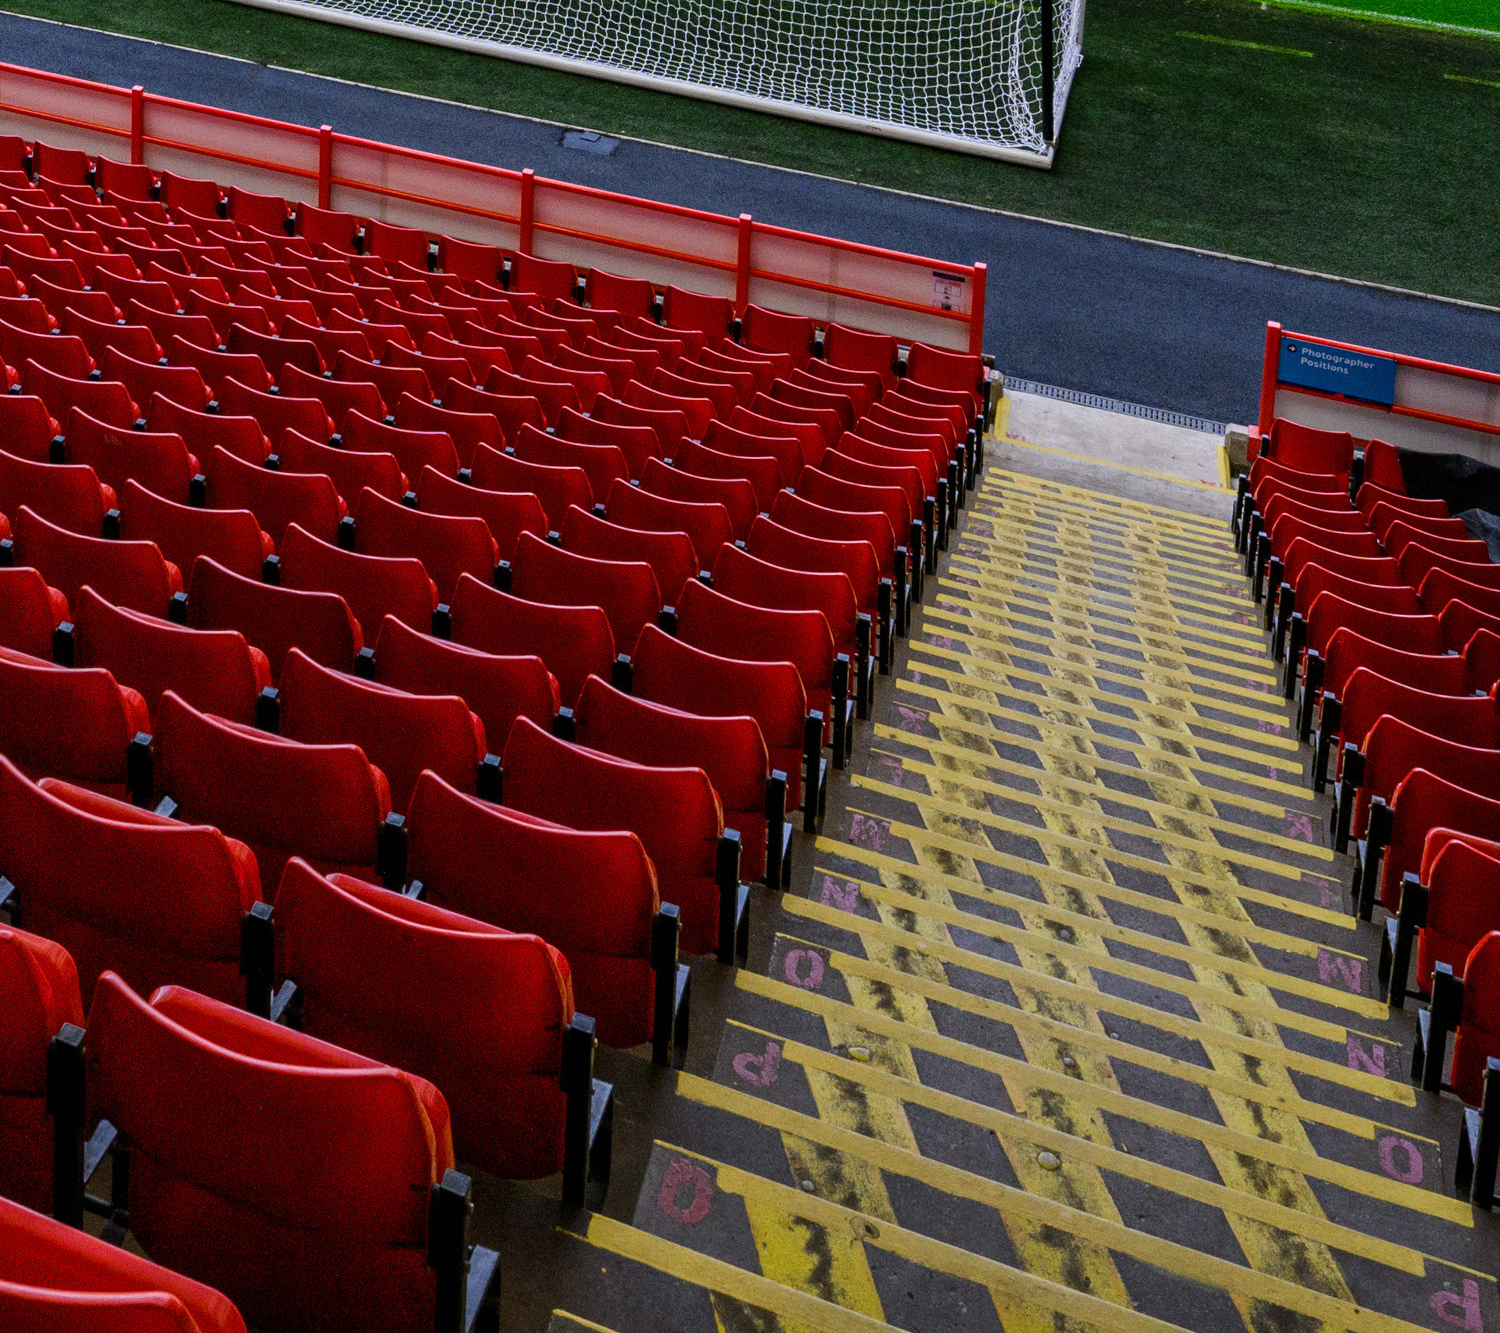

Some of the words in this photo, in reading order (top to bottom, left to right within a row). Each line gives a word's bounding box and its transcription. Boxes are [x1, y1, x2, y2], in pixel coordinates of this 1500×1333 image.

[1300, 356, 1349, 375] Positions
[1301, 347, 1375, 370] Photographer
[849, 811, 891, 851] M
[820, 875, 860, 915] N
[784, 948, 824, 989] O
[1316, 947, 1362, 994] M
[731, 1039, 782, 1087] P
[1345, 1032, 1391, 1078] N
[1378, 1137, 1424, 1184] O
[1428, 1278, 1483, 1333] P
